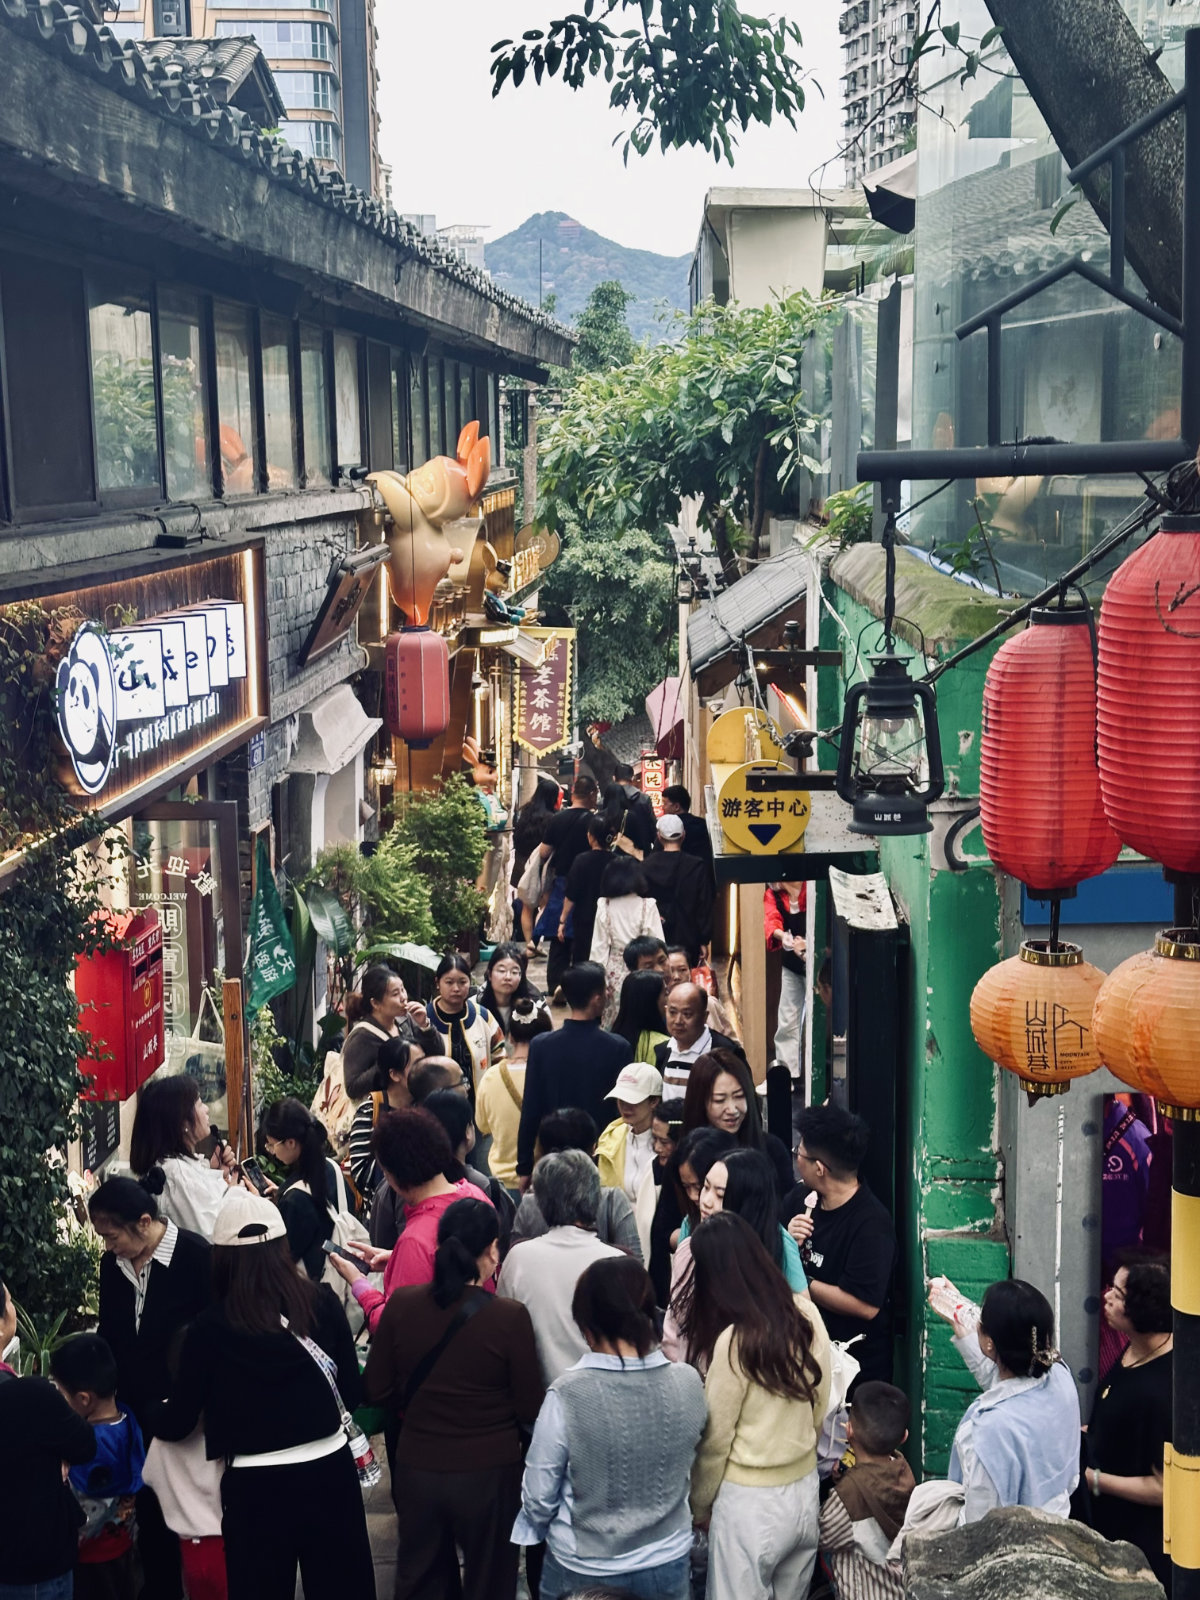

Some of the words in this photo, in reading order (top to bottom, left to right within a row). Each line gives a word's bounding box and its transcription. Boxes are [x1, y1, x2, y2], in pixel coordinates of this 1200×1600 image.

[721, 797, 808, 818] 游客中心
[1024, 999, 1051, 1077] 山城巷
